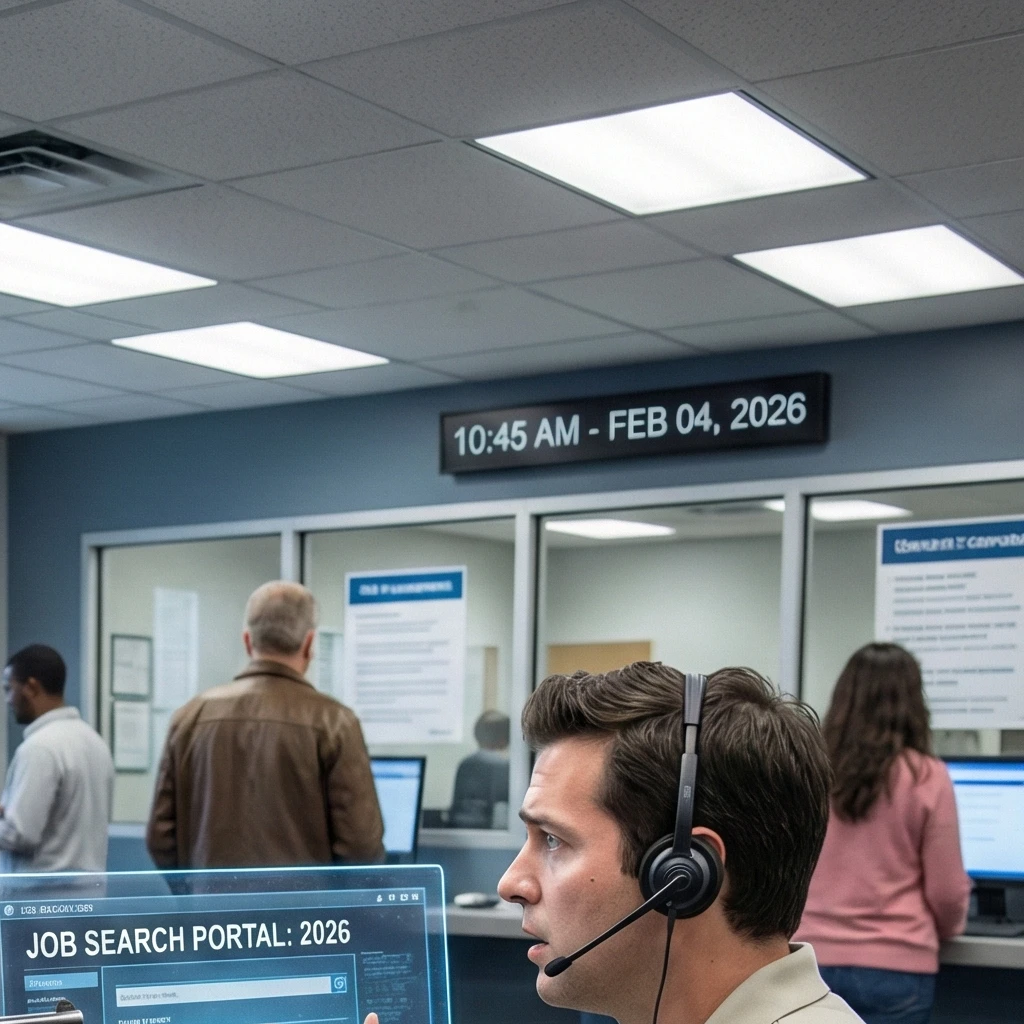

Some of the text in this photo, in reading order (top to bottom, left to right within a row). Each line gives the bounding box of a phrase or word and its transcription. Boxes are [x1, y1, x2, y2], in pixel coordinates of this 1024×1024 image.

[454, 420, 527, 456] 10:45
[534, 414, 579, 449] AM
[609, 406, 668, 442] FEB
[676, 401, 721, 437] 04,
[730, 392, 807, 431] 2026
[26, 919, 351, 959] JOB SEARCH PORTAL: 2026
